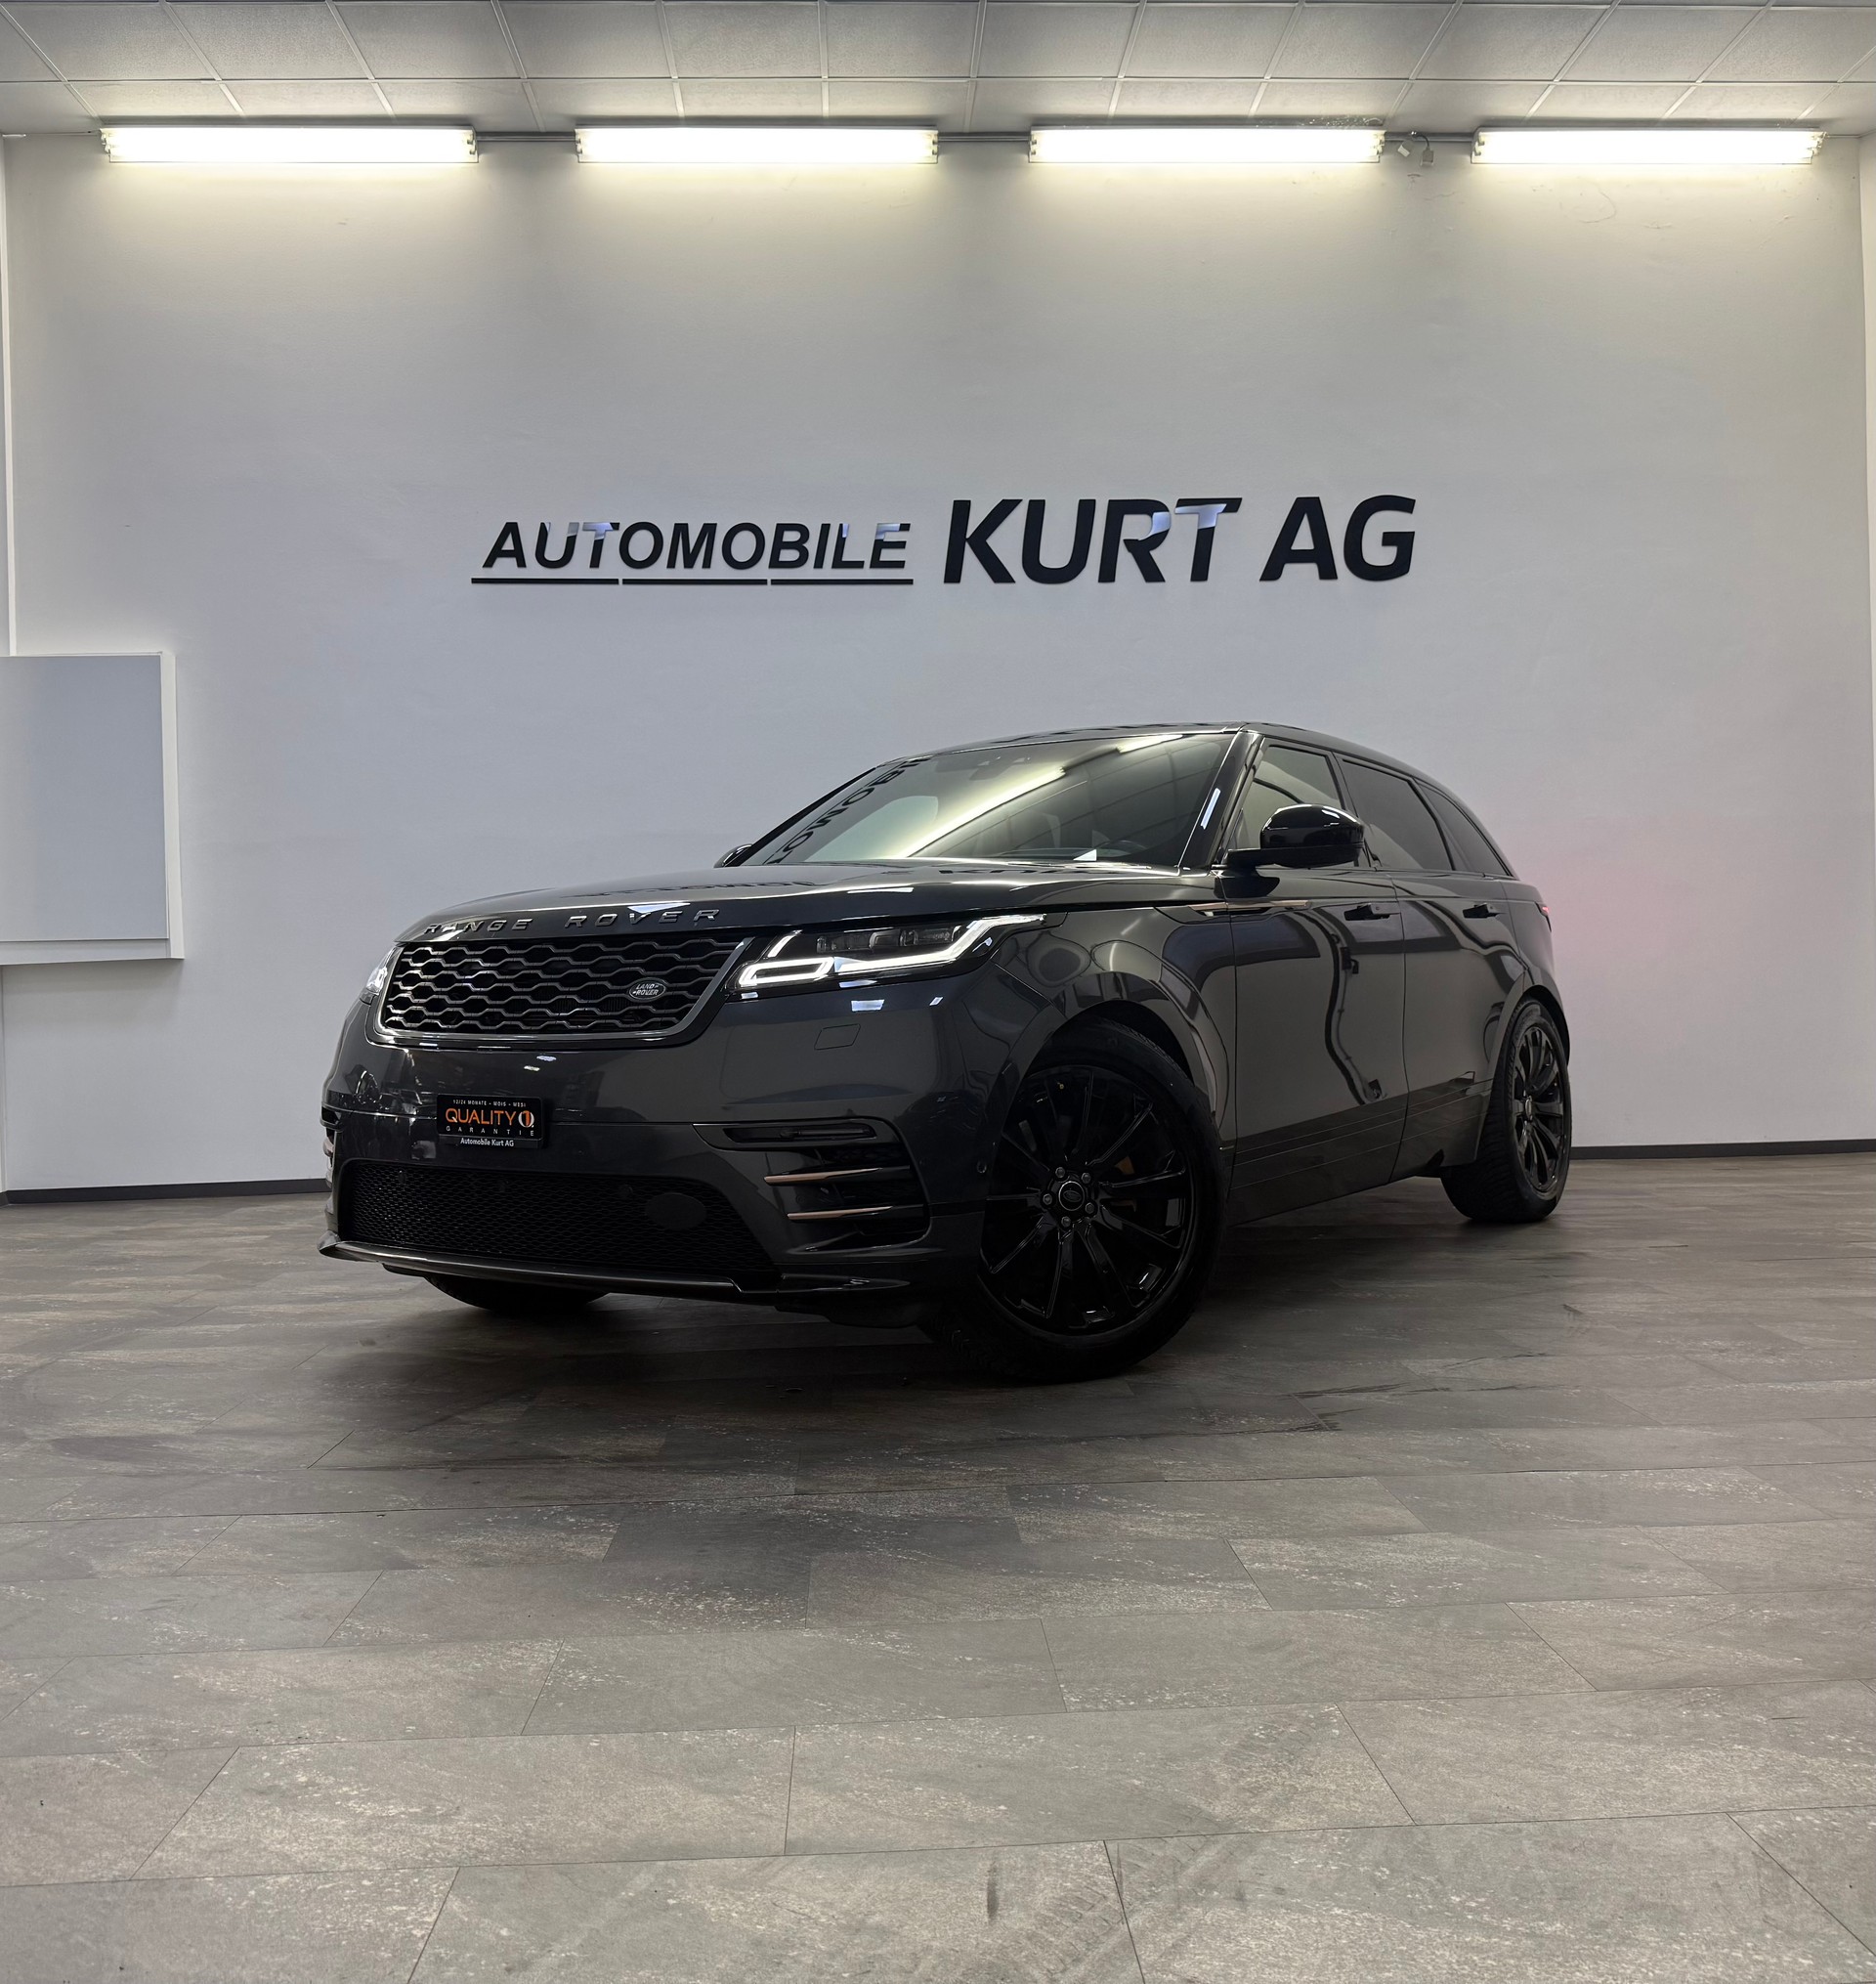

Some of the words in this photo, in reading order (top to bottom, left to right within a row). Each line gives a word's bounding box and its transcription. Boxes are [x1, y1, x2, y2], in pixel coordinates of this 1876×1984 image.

[482, 521, 911, 569] AUTOMOBILE
[943, 496, 1242, 584] KURT
[1258, 495, 1416, 582] AG
[423, 919, 533, 934] RANGE
[564, 909, 720, 927] ROVER
[446, 1108, 516, 1126] QUALITY
[446, 1126, 534, 1137] GARANTIE
[460, 1138, 490, 1146] Automobile
